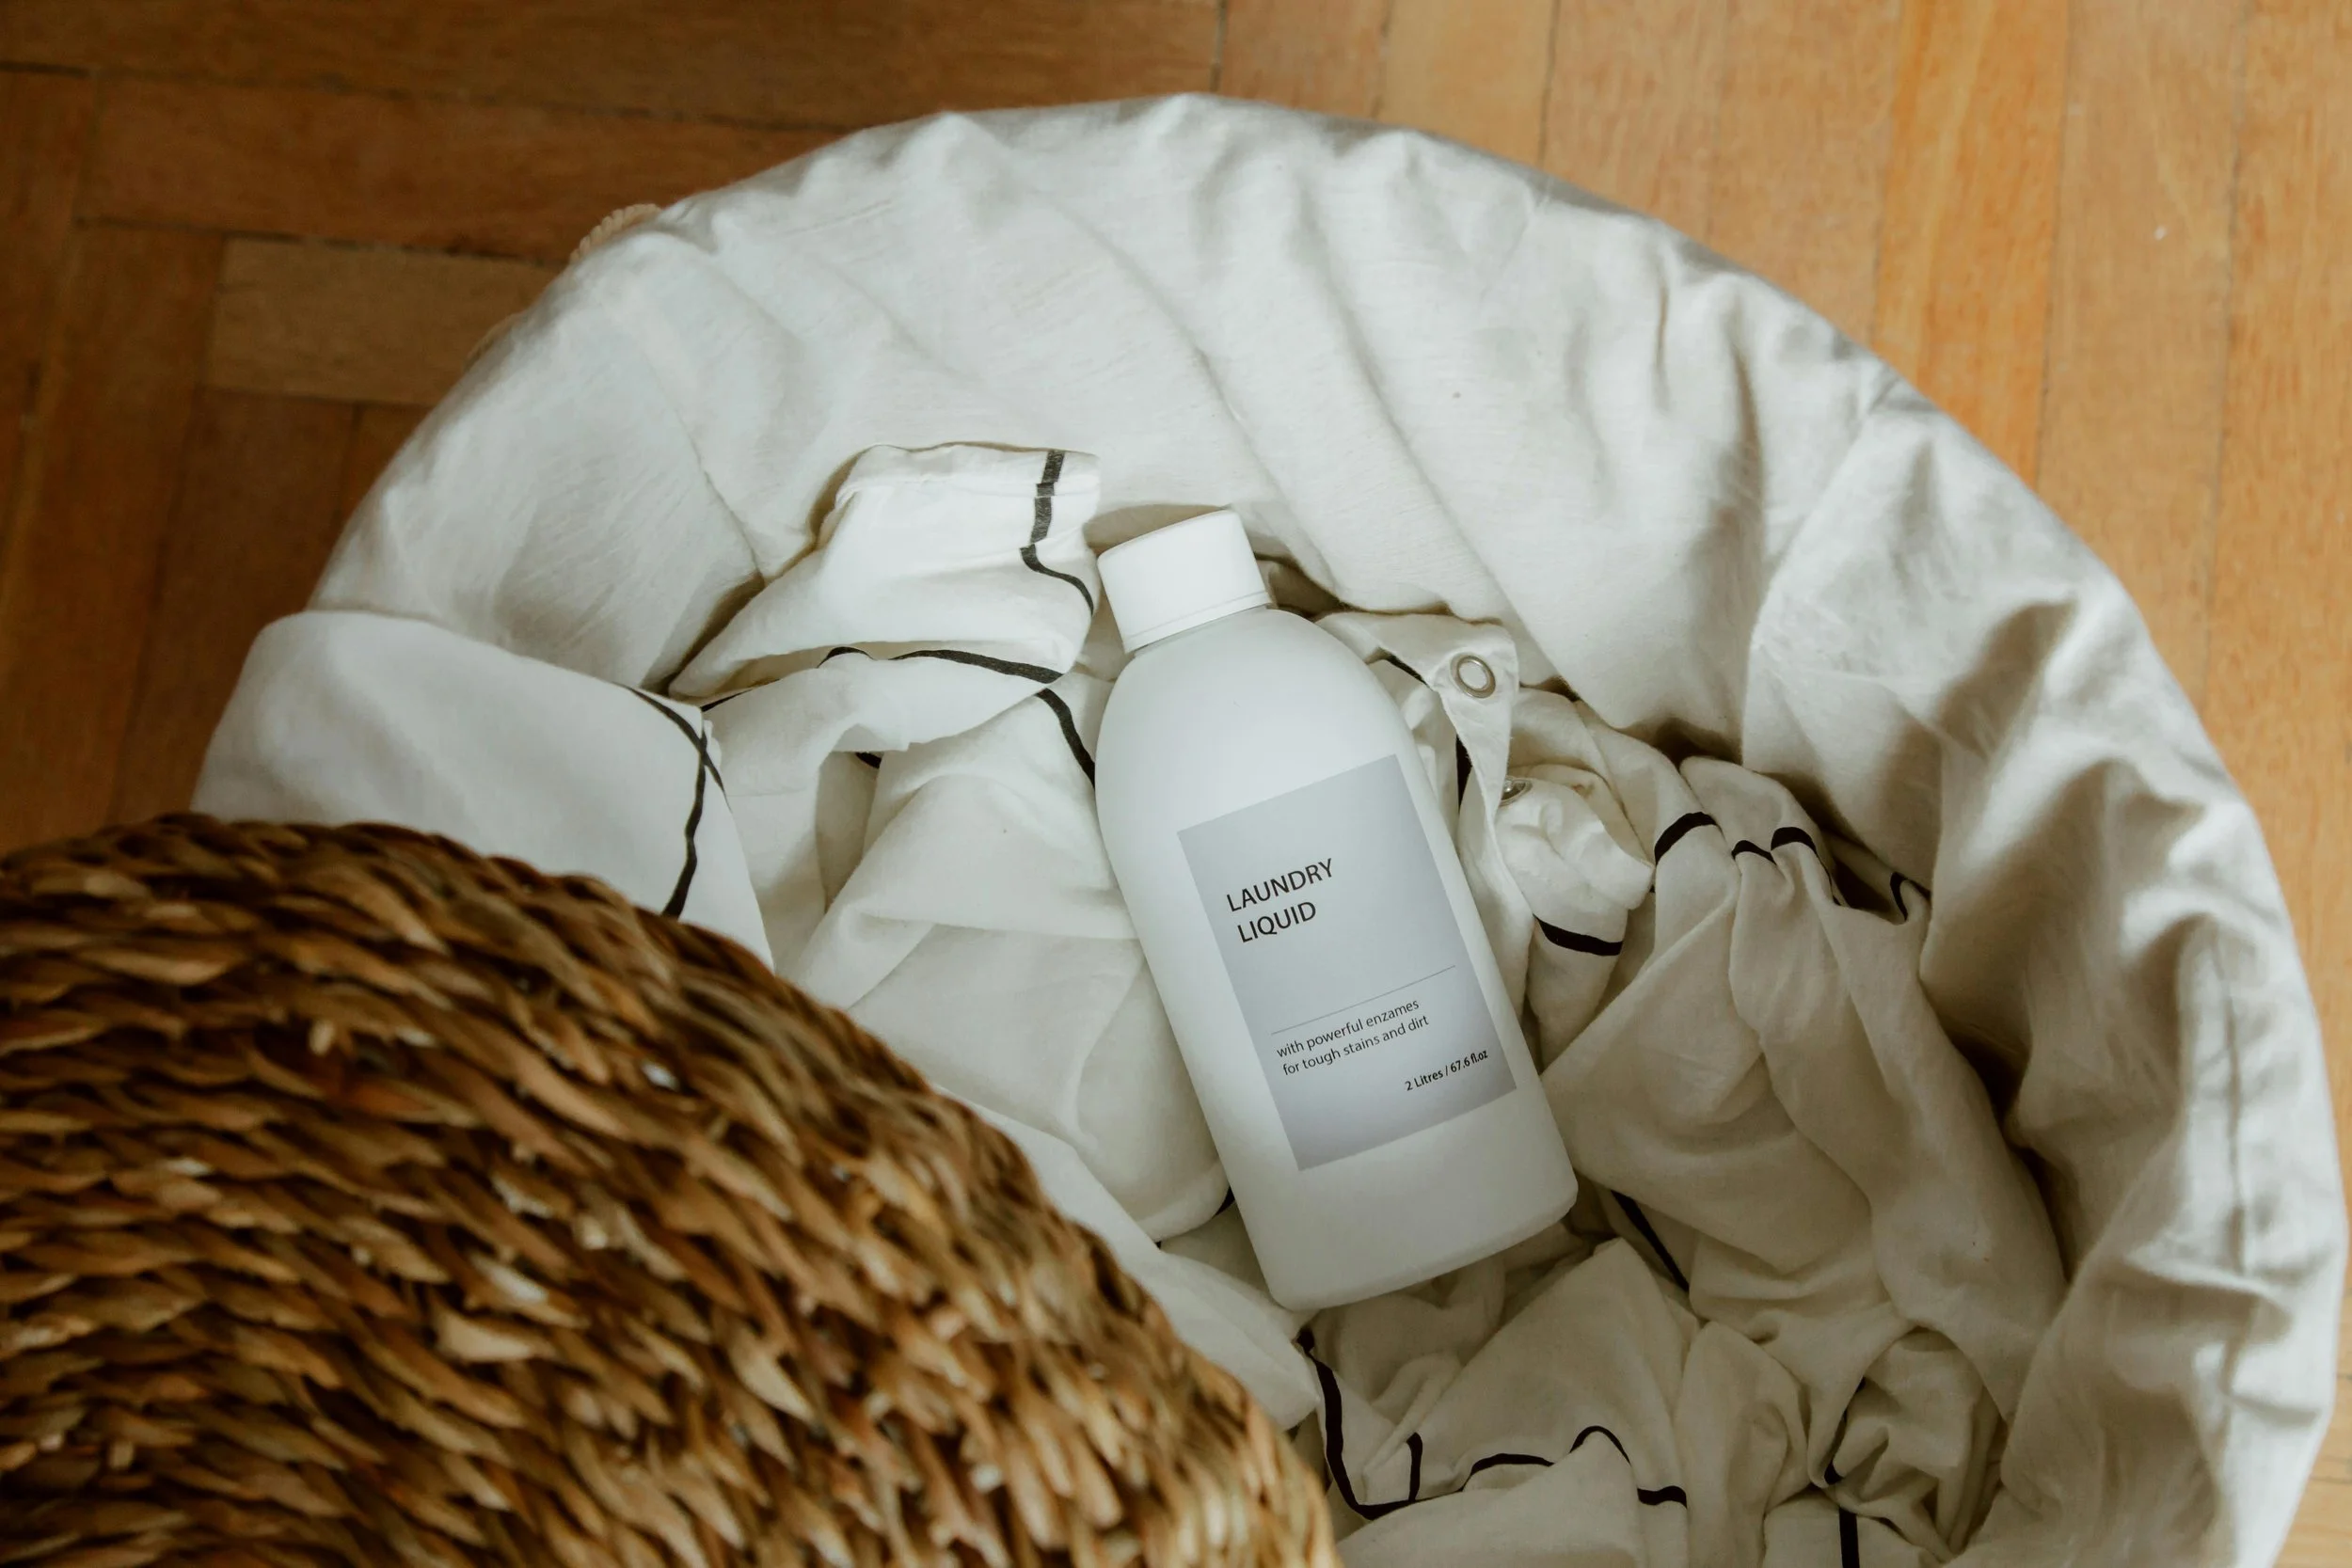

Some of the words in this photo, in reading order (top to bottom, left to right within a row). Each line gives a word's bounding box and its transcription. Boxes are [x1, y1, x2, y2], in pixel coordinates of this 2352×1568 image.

[1226, 857, 1333, 912] LAUNDRY
[1237, 901, 1317, 943] LIQUID
[1276, 1039, 1305, 1058] with
[1307, 1019, 1364, 1052] powerful
[1366, 1000, 1420, 1027] enzames
[1282, 1062, 1300, 1076] for
[1302, 1047, 1342, 1069] tough
[1343, 1036, 1381, 1056] stains
[1382, 1022, 1406, 1042] and
[1407, 1015, 1429, 1032] dirt
[1405, 1080, 1413, 1091] 2
[1413, 1069, 1444, 1087] Litres
[1444, 1064, 1449, 1076] /
[1450, 1055, 1470, 1073] 67.6
[1470, 1050, 1488, 1064] fl.oz
